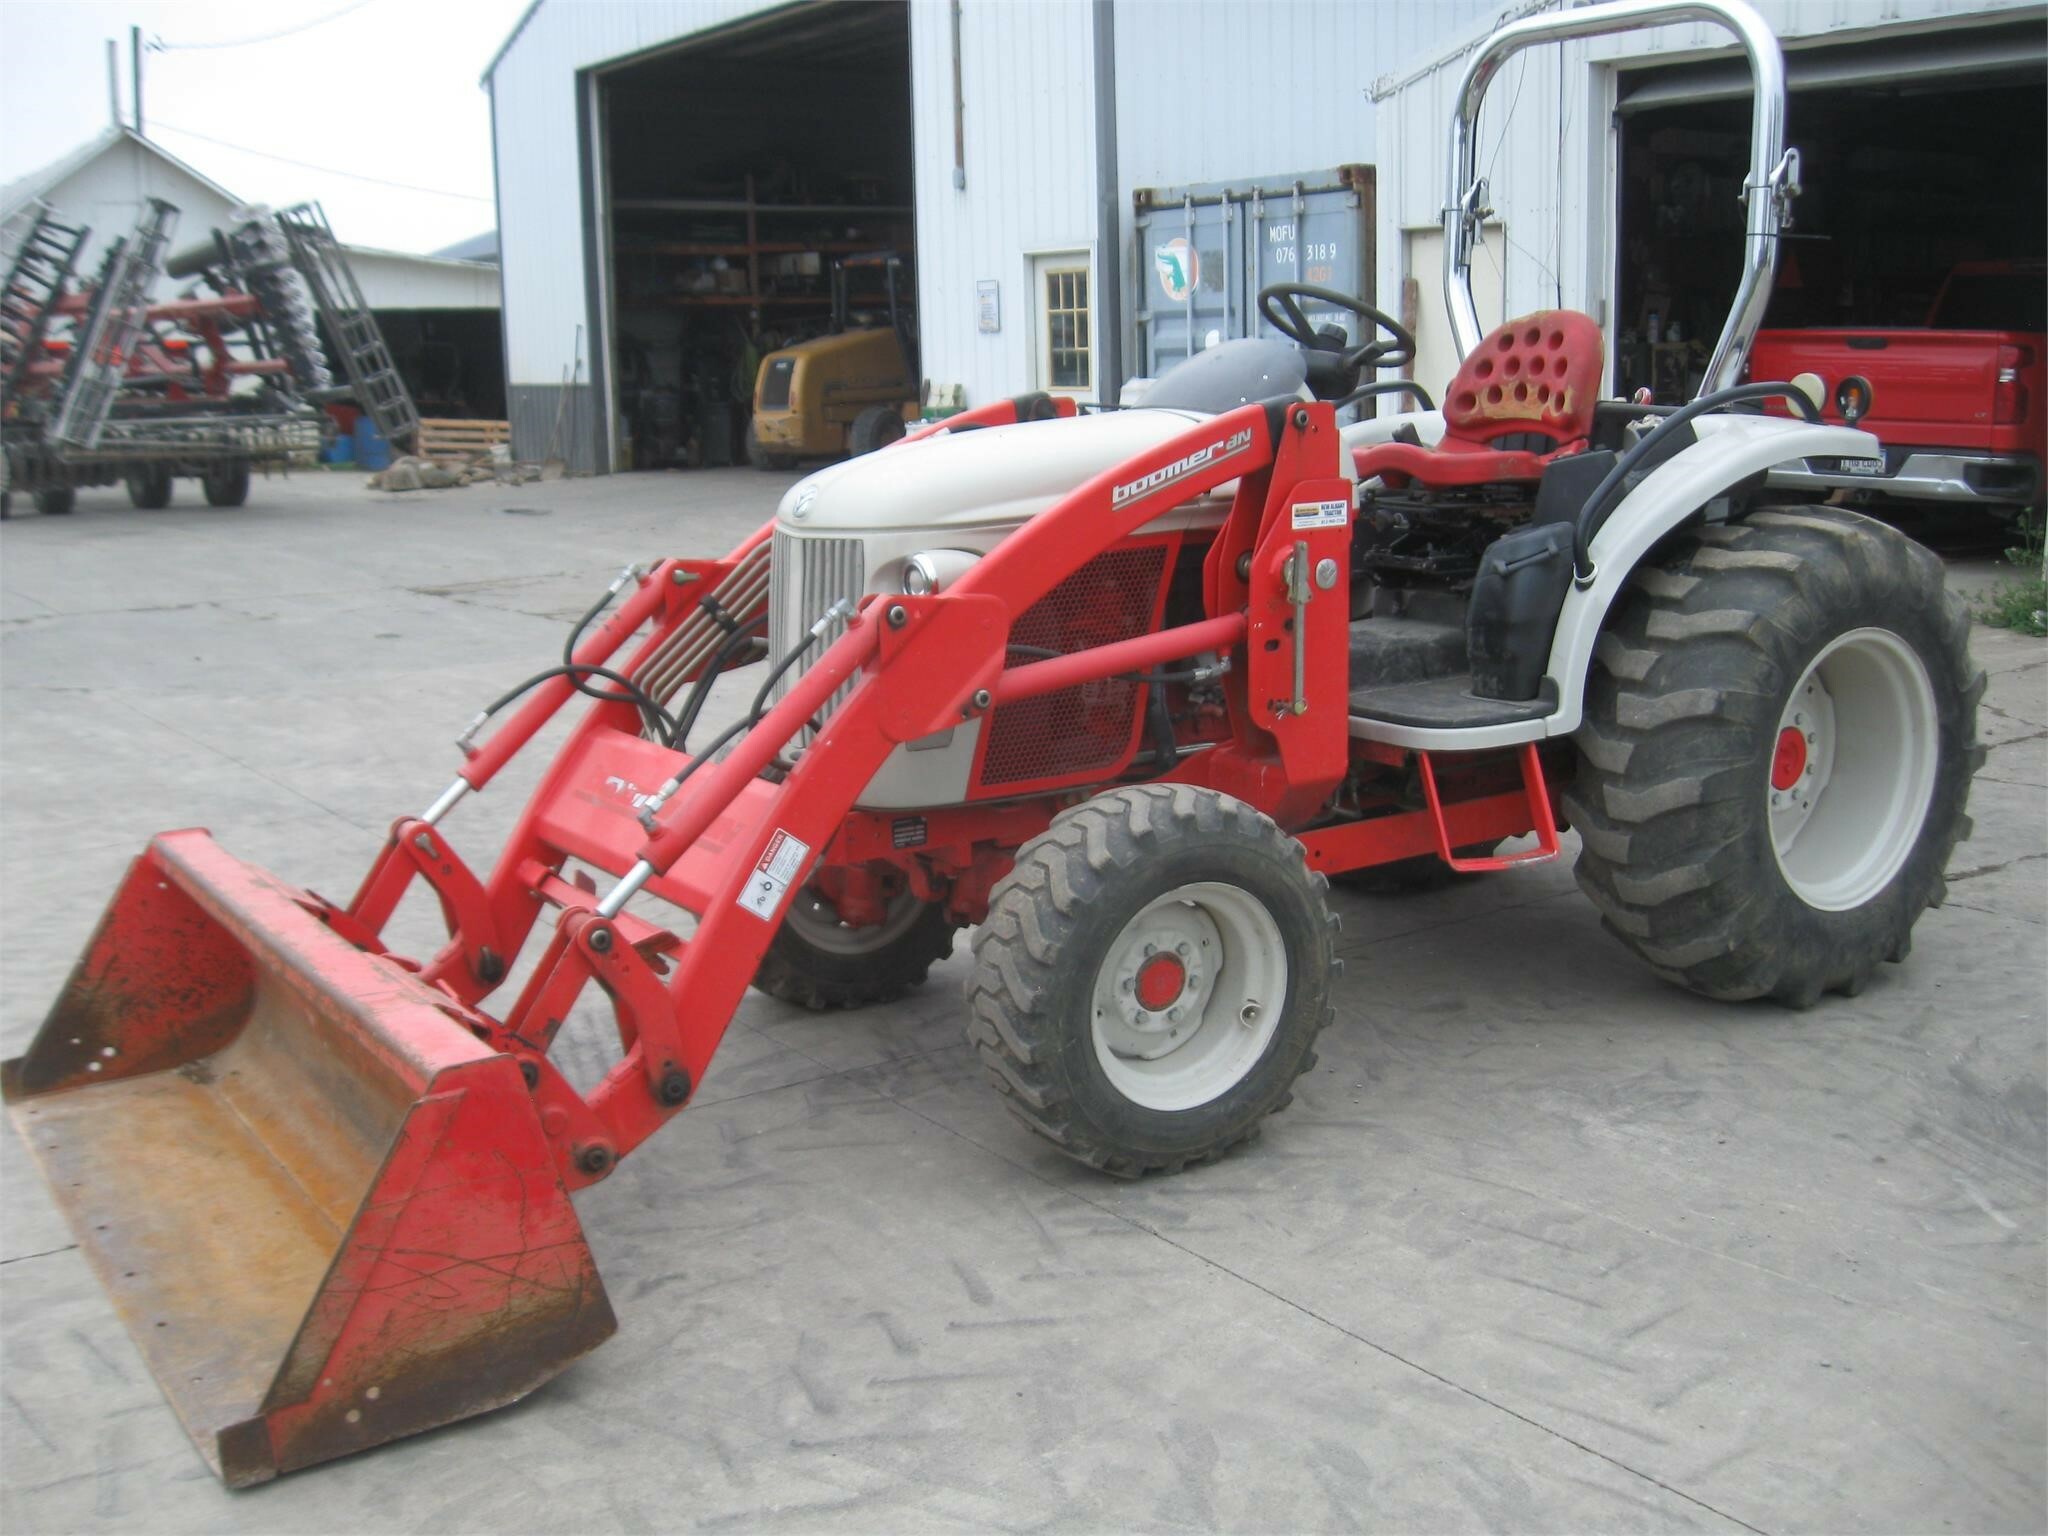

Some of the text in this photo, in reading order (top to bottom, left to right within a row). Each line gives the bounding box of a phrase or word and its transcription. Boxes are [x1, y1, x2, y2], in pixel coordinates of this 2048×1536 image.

[1269, 224, 1295, 242] MOFU
[1276, 243, 1337, 263] 076 318 9
[1112, 440, 1224, 504] boomer
[765, 833, 784, 862] DANGER
